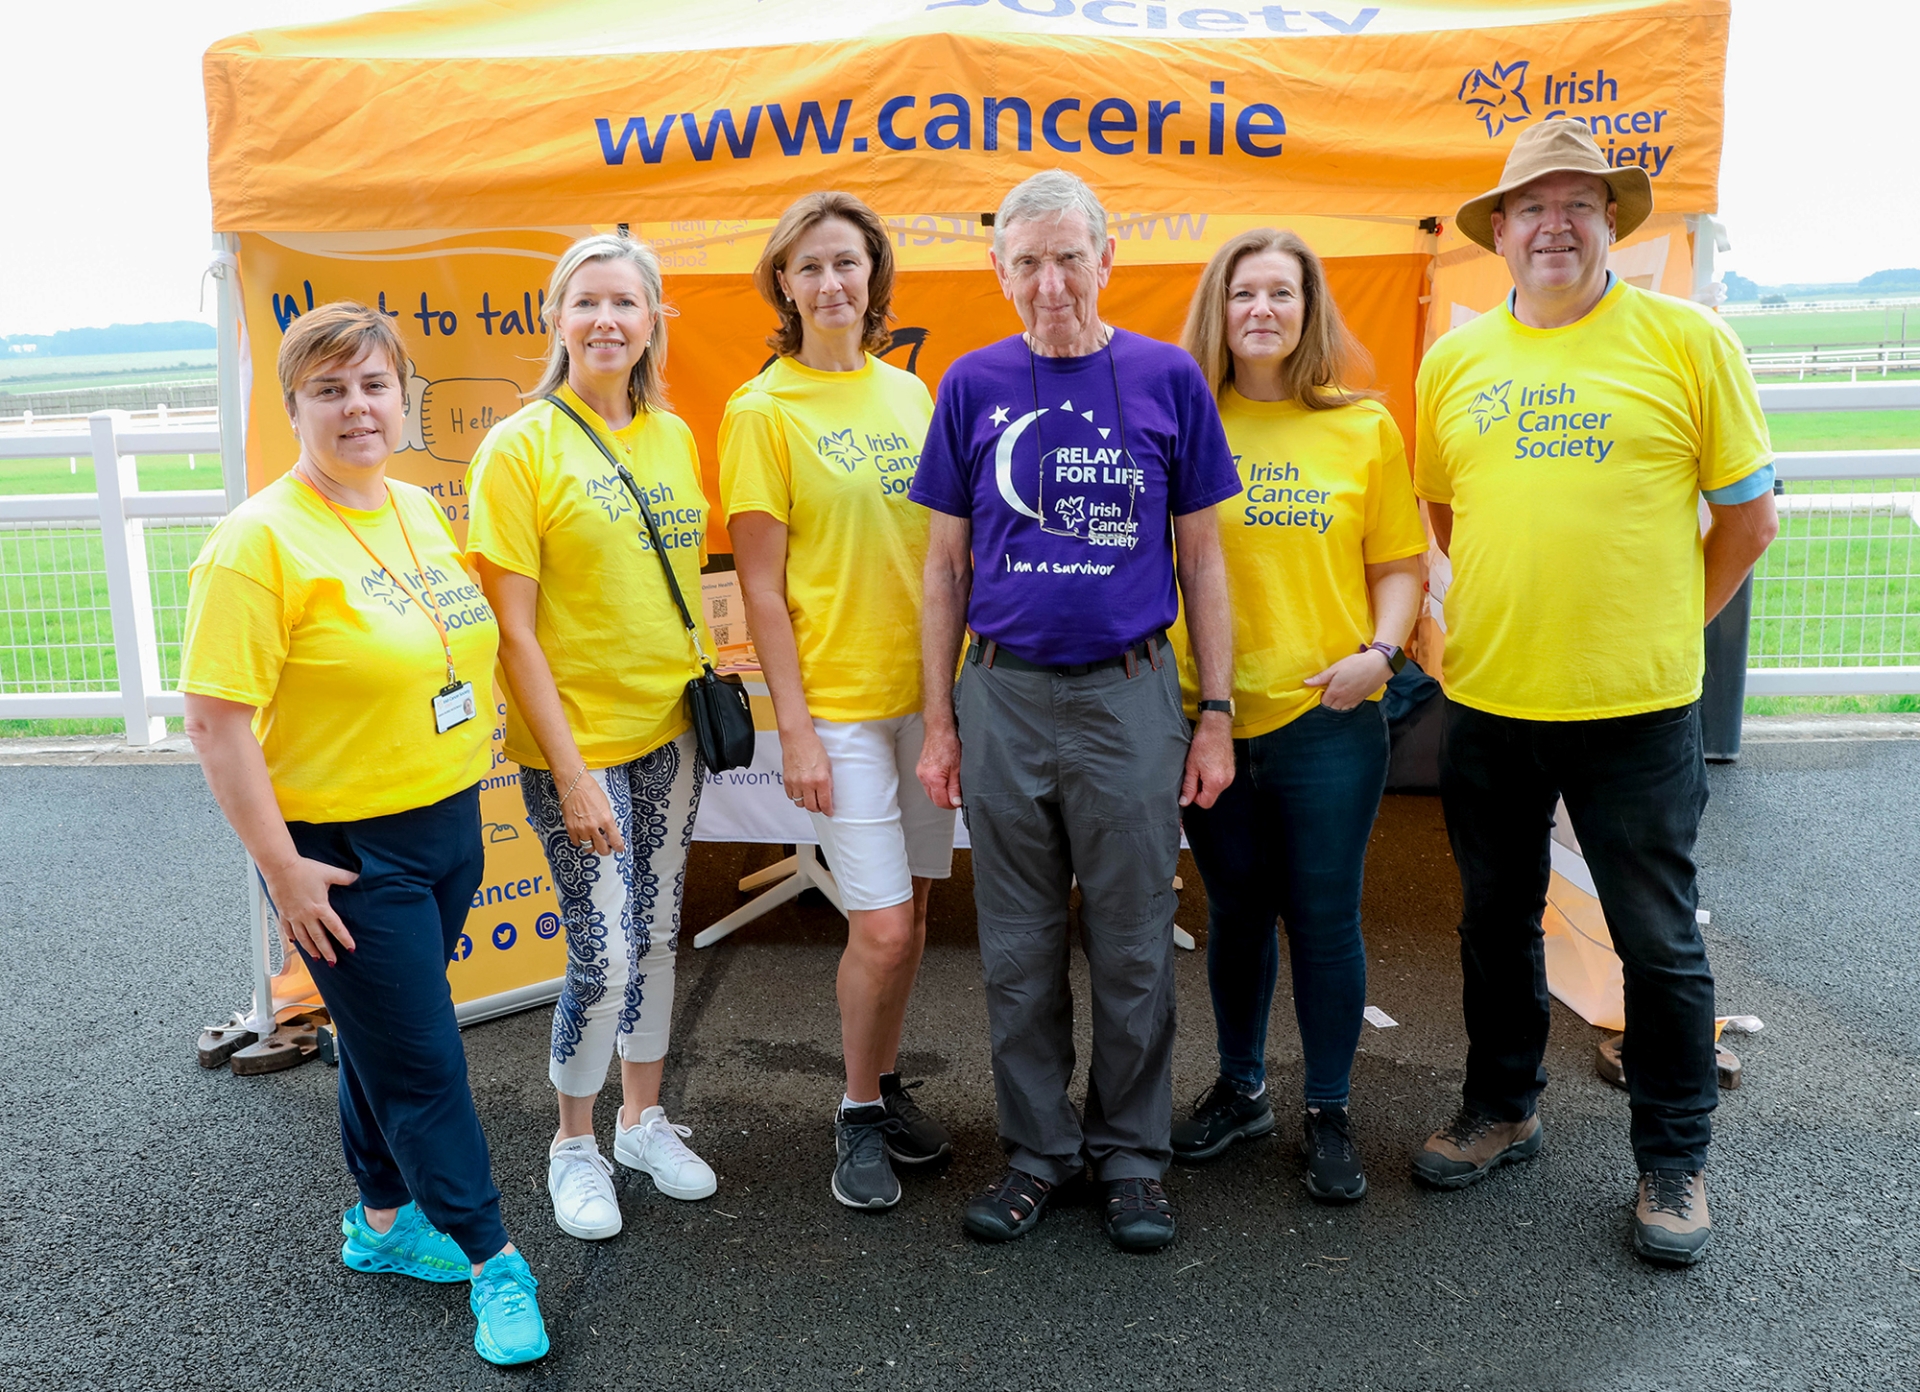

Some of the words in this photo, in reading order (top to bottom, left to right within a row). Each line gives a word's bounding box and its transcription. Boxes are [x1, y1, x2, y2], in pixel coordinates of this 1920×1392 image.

[1543, 69, 1618, 105] Irish
[594, 80, 1287, 166] www.cancer.ie
[413, 290, 458, 337] to
[1520, 382, 1576, 407] Irish
[1517, 409, 1613, 433] Cancer
[864, 431, 910, 453] Irish
[1514, 433, 1615, 464] Society
[1055, 447, 1123, 465] RELAY
[1055, 466, 1098, 484] FOR
[1102, 466, 1145, 487] LIFE
[1249, 462, 1300, 482] Irish
[1246, 483, 1331, 505] Cancer
[1089, 501, 1122, 518] Irish
[1243, 504, 1335, 535] Society
[1087, 517, 1139, 534] Cancer
[1004, 553, 1011, 573] I
[1013, 560, 1033, 573] am
[1036, 560, 1049, 573] a
[1052, 559, 1116, 576] survivor
[402, 564, 449, 590] Irish
